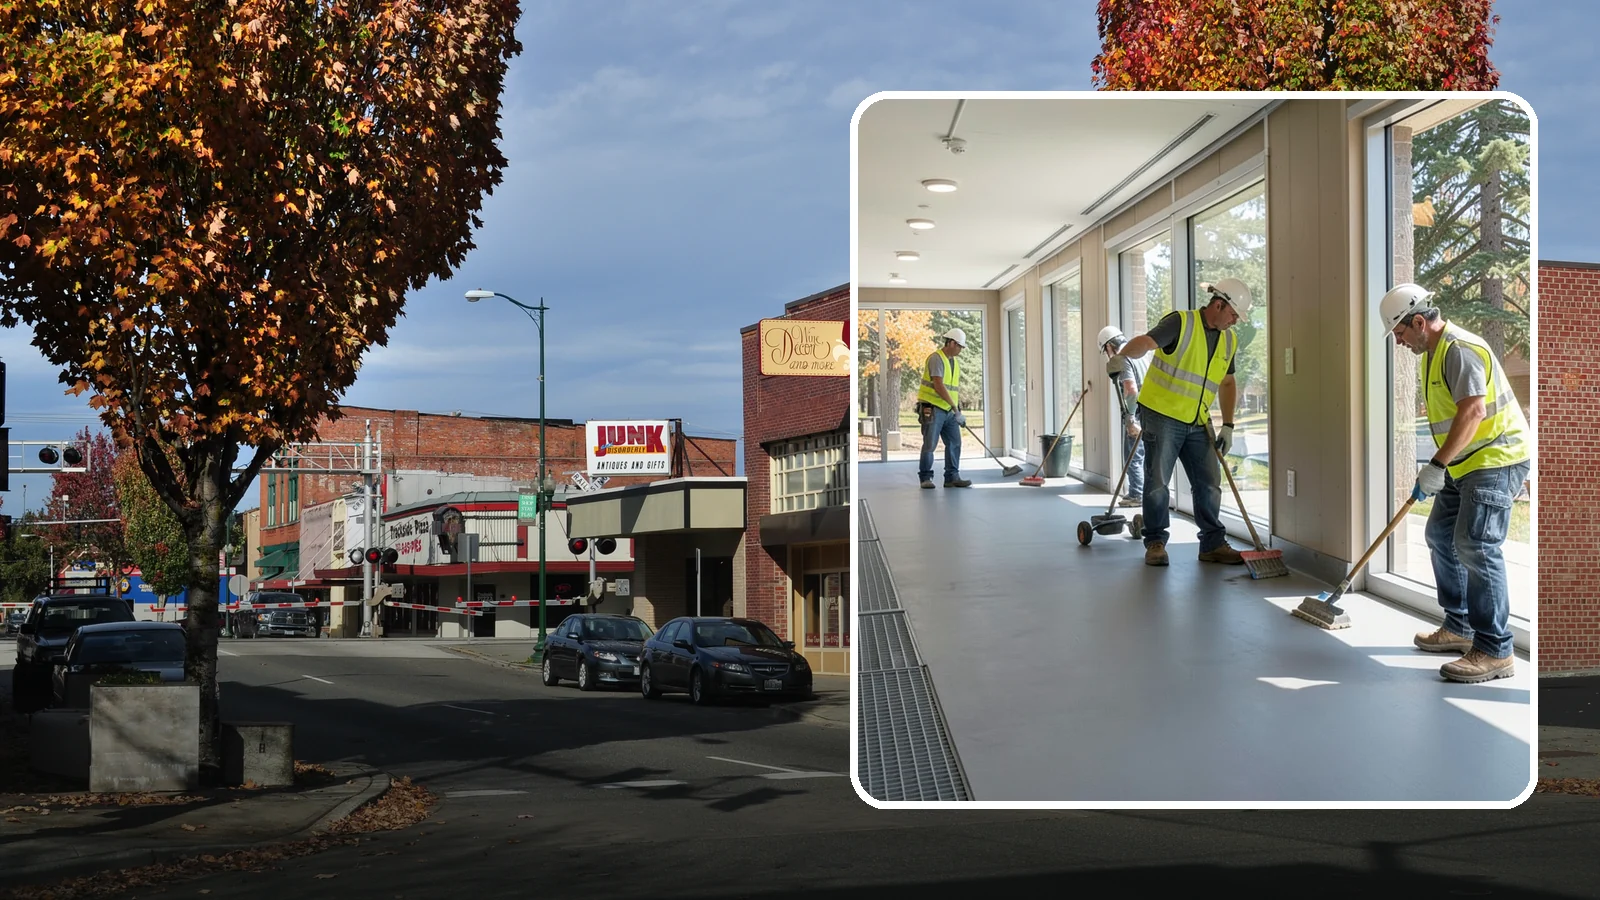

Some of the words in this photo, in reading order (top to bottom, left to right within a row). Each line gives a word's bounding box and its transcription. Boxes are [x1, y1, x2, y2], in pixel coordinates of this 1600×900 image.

[595, 425, 666, 457] JUNK
[607, 446, 646, 454] DISORDERLY
[596, 461, 628, 470] ANTIQUES
[631, 461, 644, 470] AND
[646, 460, 666, 470] GIFTS
[414, 519, 429, 535] Pizza
